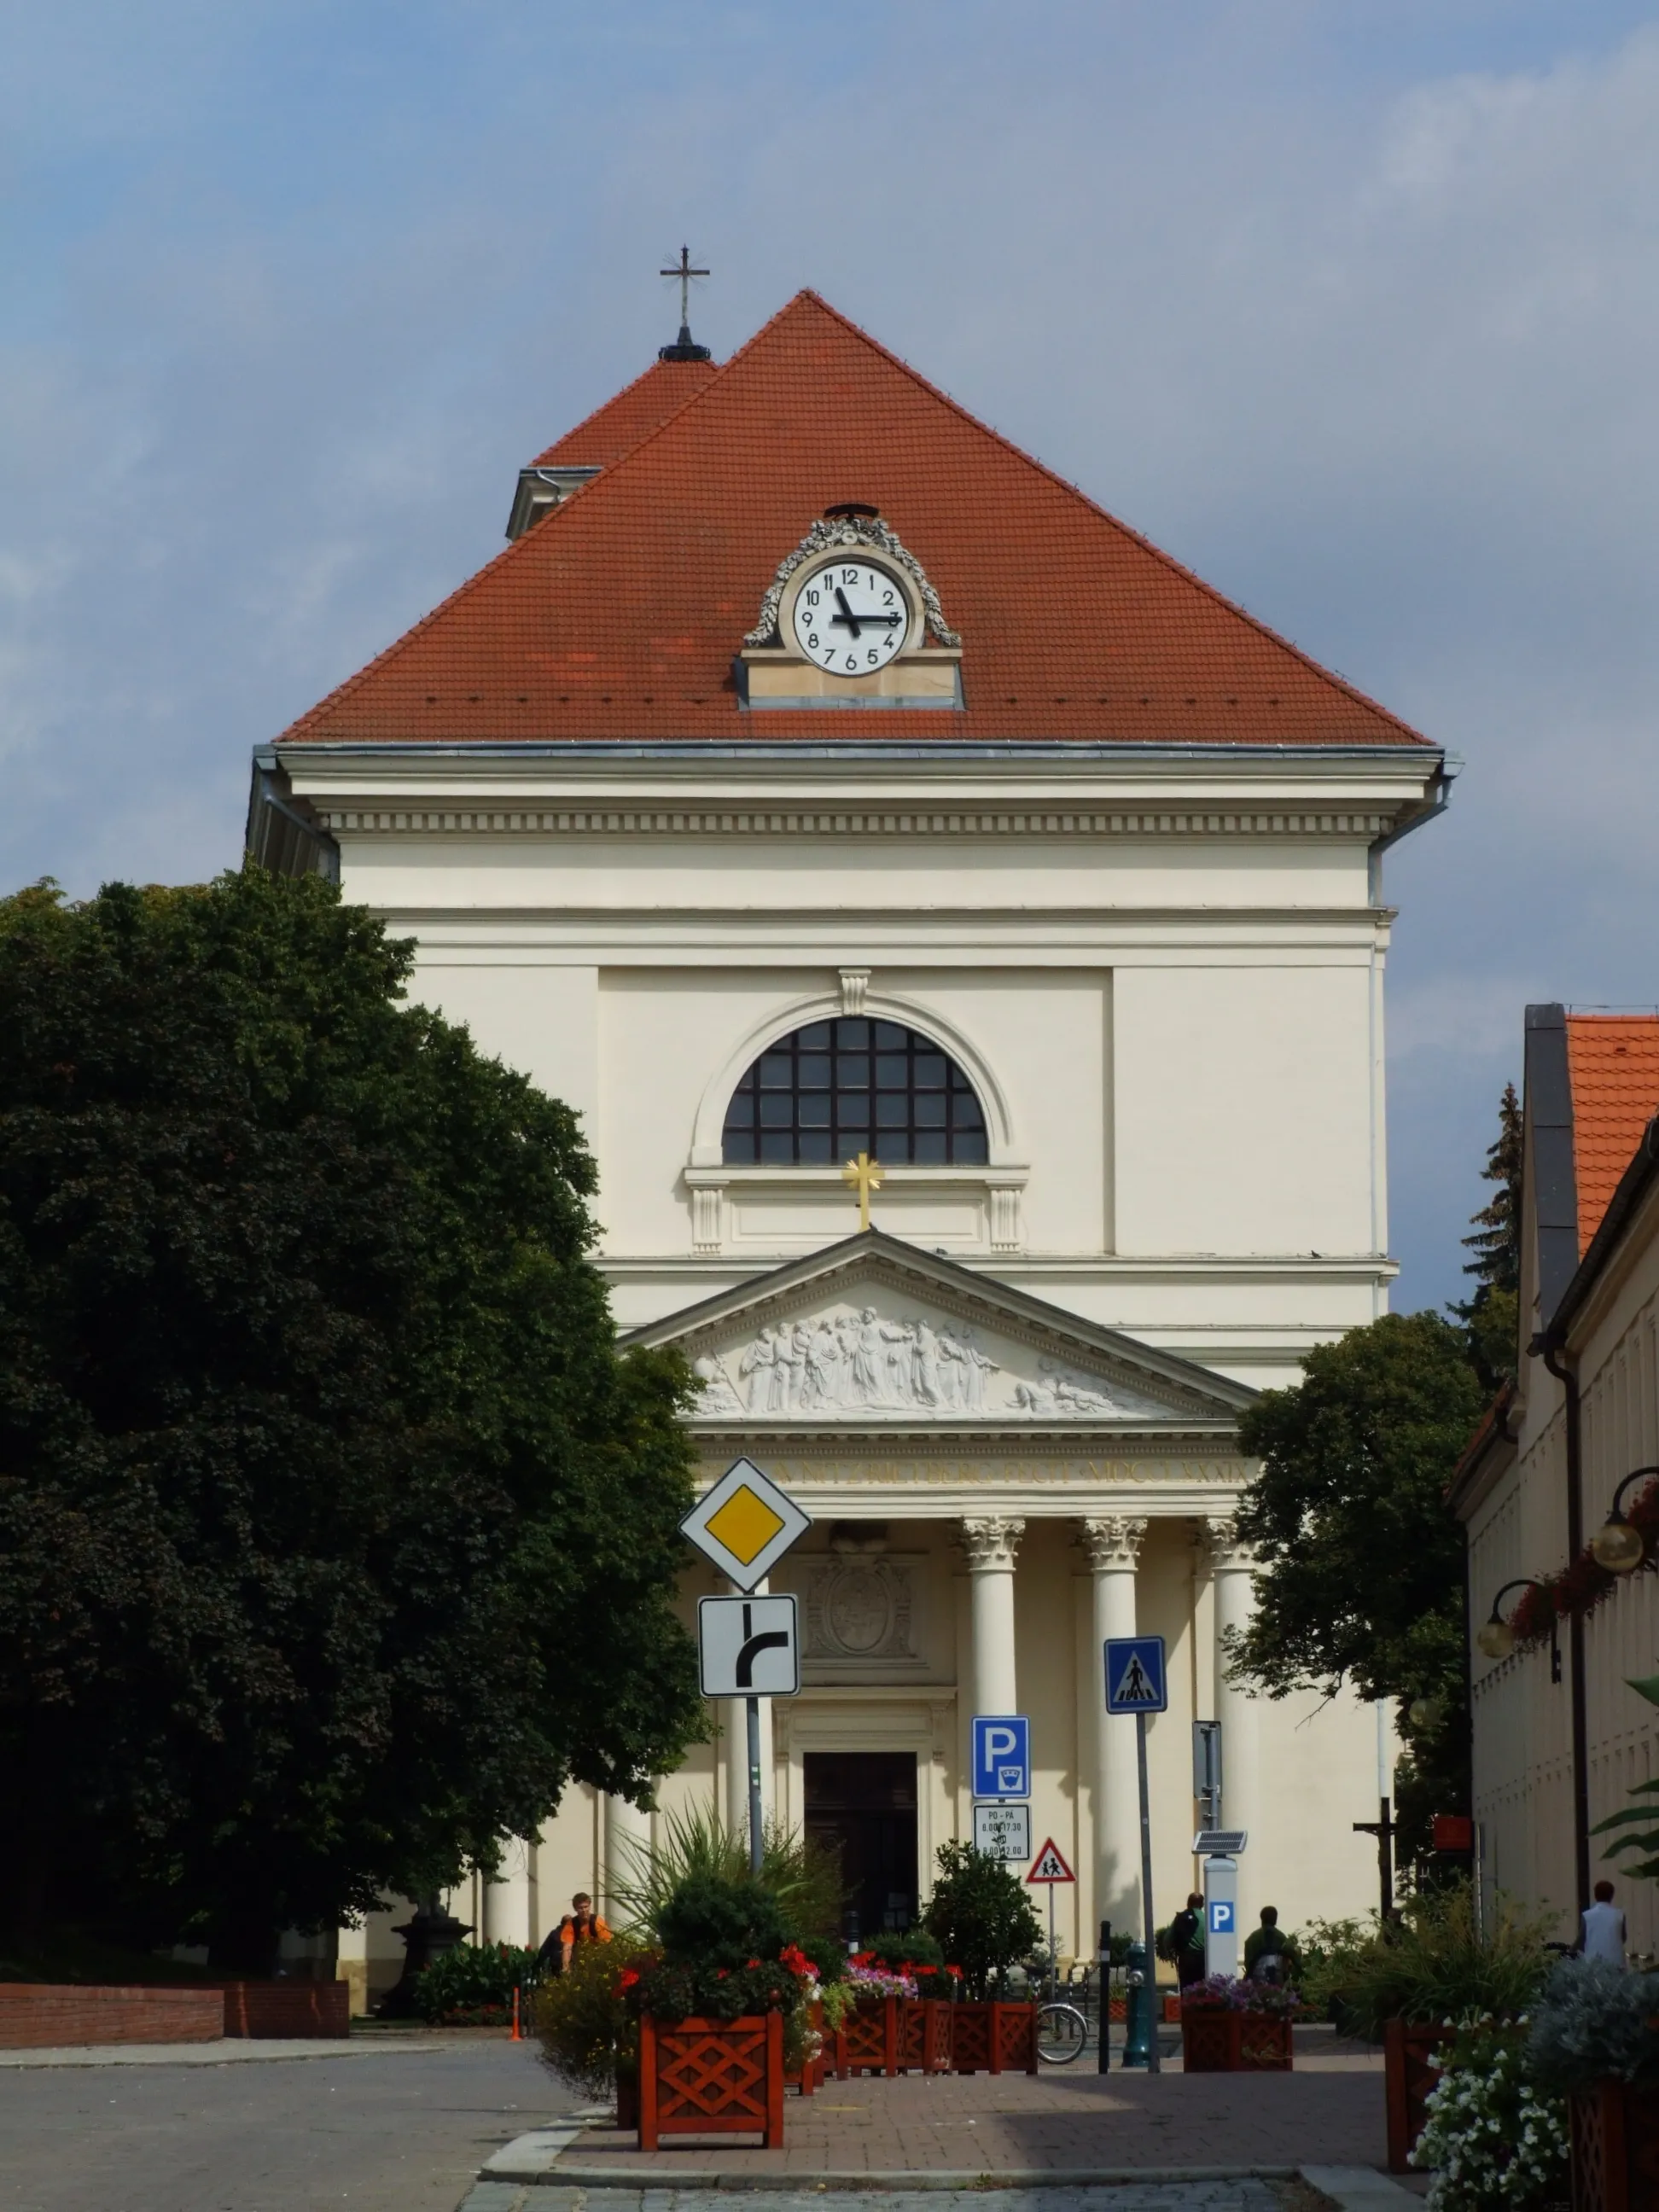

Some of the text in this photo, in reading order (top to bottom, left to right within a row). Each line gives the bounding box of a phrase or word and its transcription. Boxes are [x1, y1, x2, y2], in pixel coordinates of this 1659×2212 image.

[824, 574, 833, 591] 11
[842, 569, 859, 585] 12
[870, 575, 874, 591] 1
[806, 590, 820, 606] 10
[882, 590, 894, 606] 2
[801, 611, 813, 628] 9
[807, 632, 819, 649] 8
[883, 633, 894, 649] 4
[824, 649, 836, 665] 7
[845, 655, 857, 671] 6
[867, 649, 878, 665] 5
[985, 1726, 1016, 1773] P
[988, 1811, 998, 1819] PO
[1214, 1905, 1231, 1930] P
